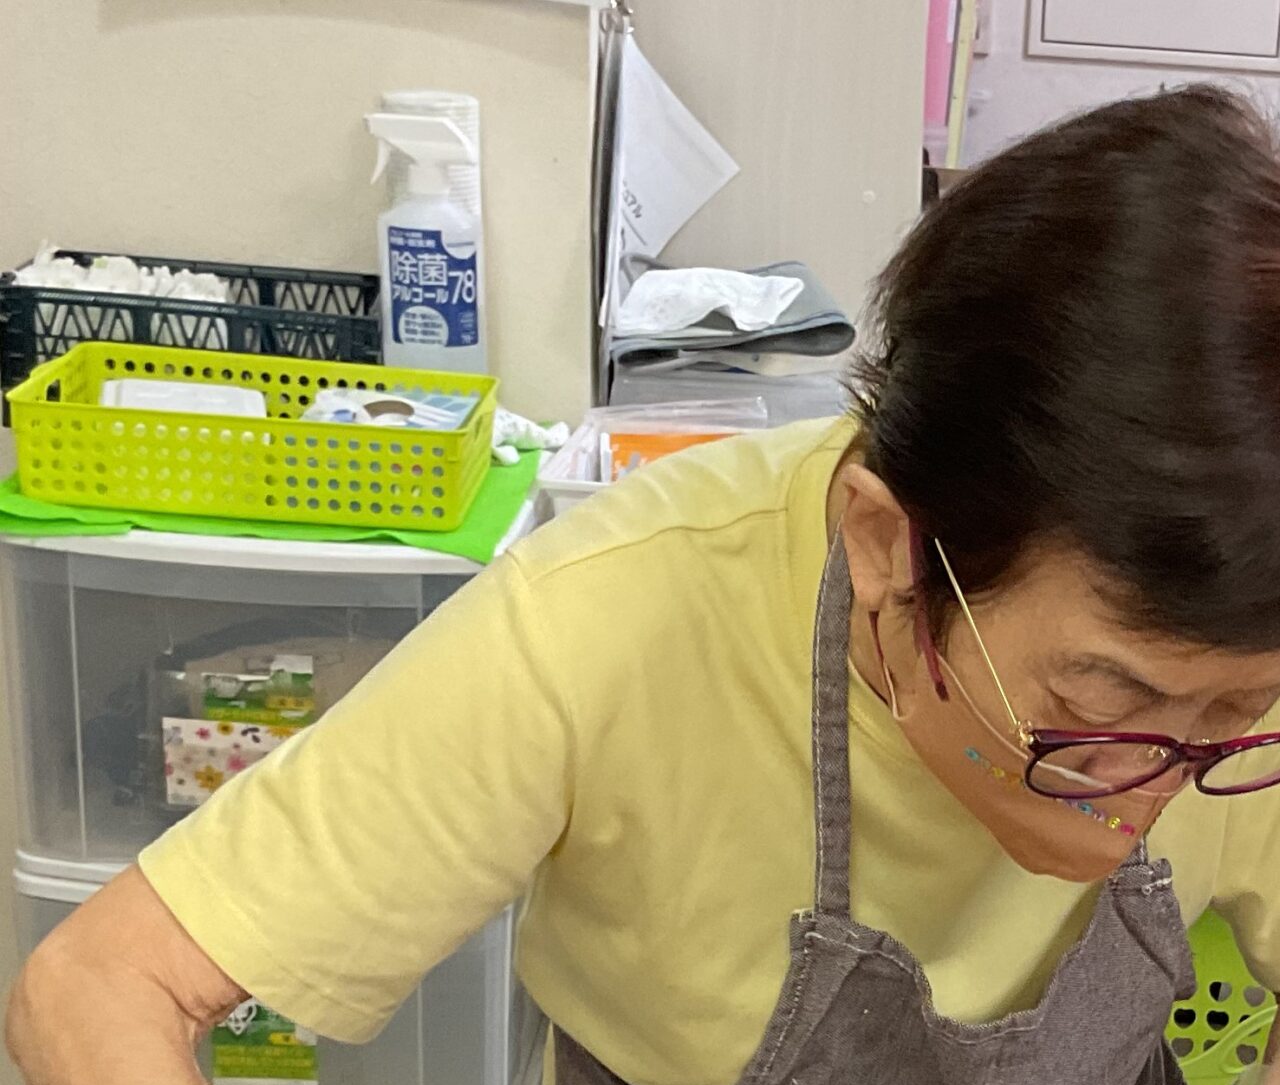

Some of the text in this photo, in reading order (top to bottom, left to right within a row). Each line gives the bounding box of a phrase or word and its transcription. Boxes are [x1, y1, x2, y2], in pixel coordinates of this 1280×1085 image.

[391, 250, 447, 285] 除菌
[393, 284, 449, 304] アルコール
[448, 269, 476, 305] 78
